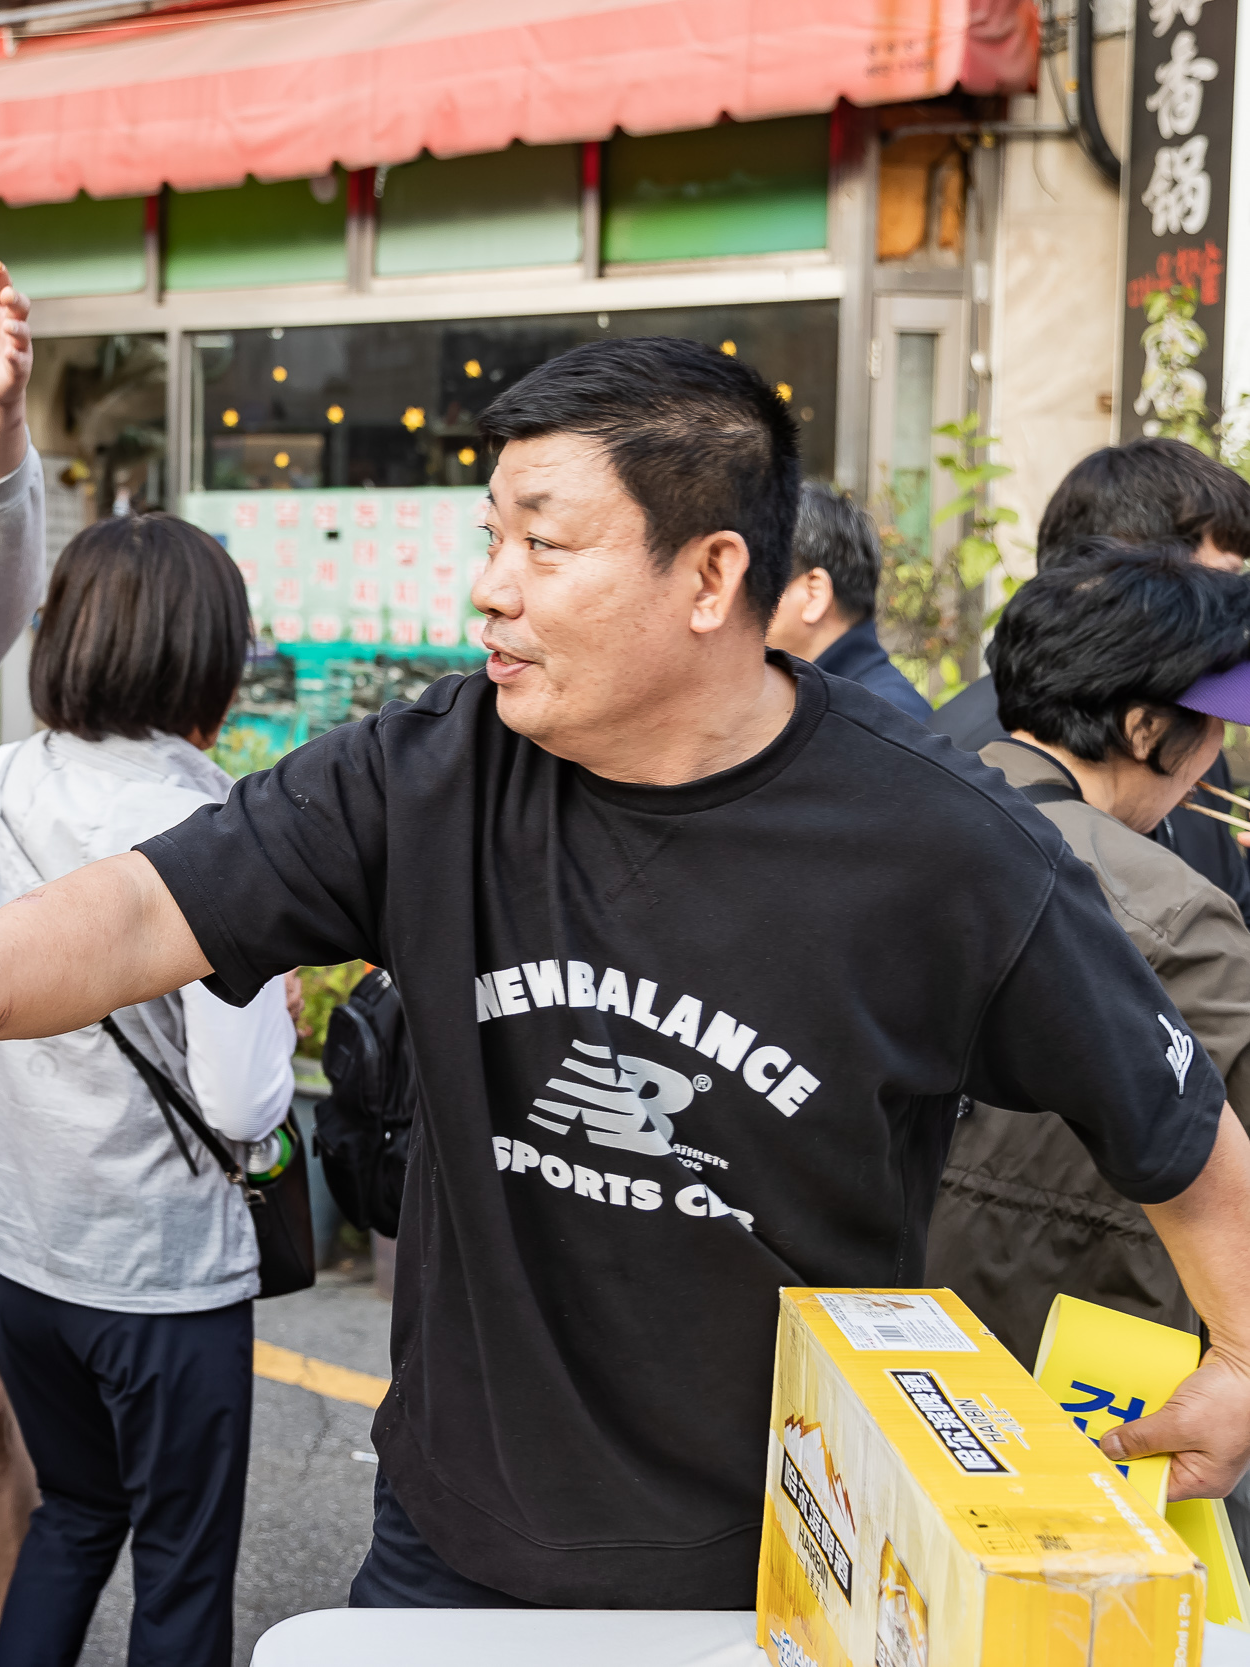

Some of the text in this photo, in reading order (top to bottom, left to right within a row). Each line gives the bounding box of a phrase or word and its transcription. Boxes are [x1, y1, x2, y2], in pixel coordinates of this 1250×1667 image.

[492, 1136, 663, 1211] SPORTS
[954, 1398, 1007, 1443] HARBIN
[798, 1520, 829, 1591] HARBIN
